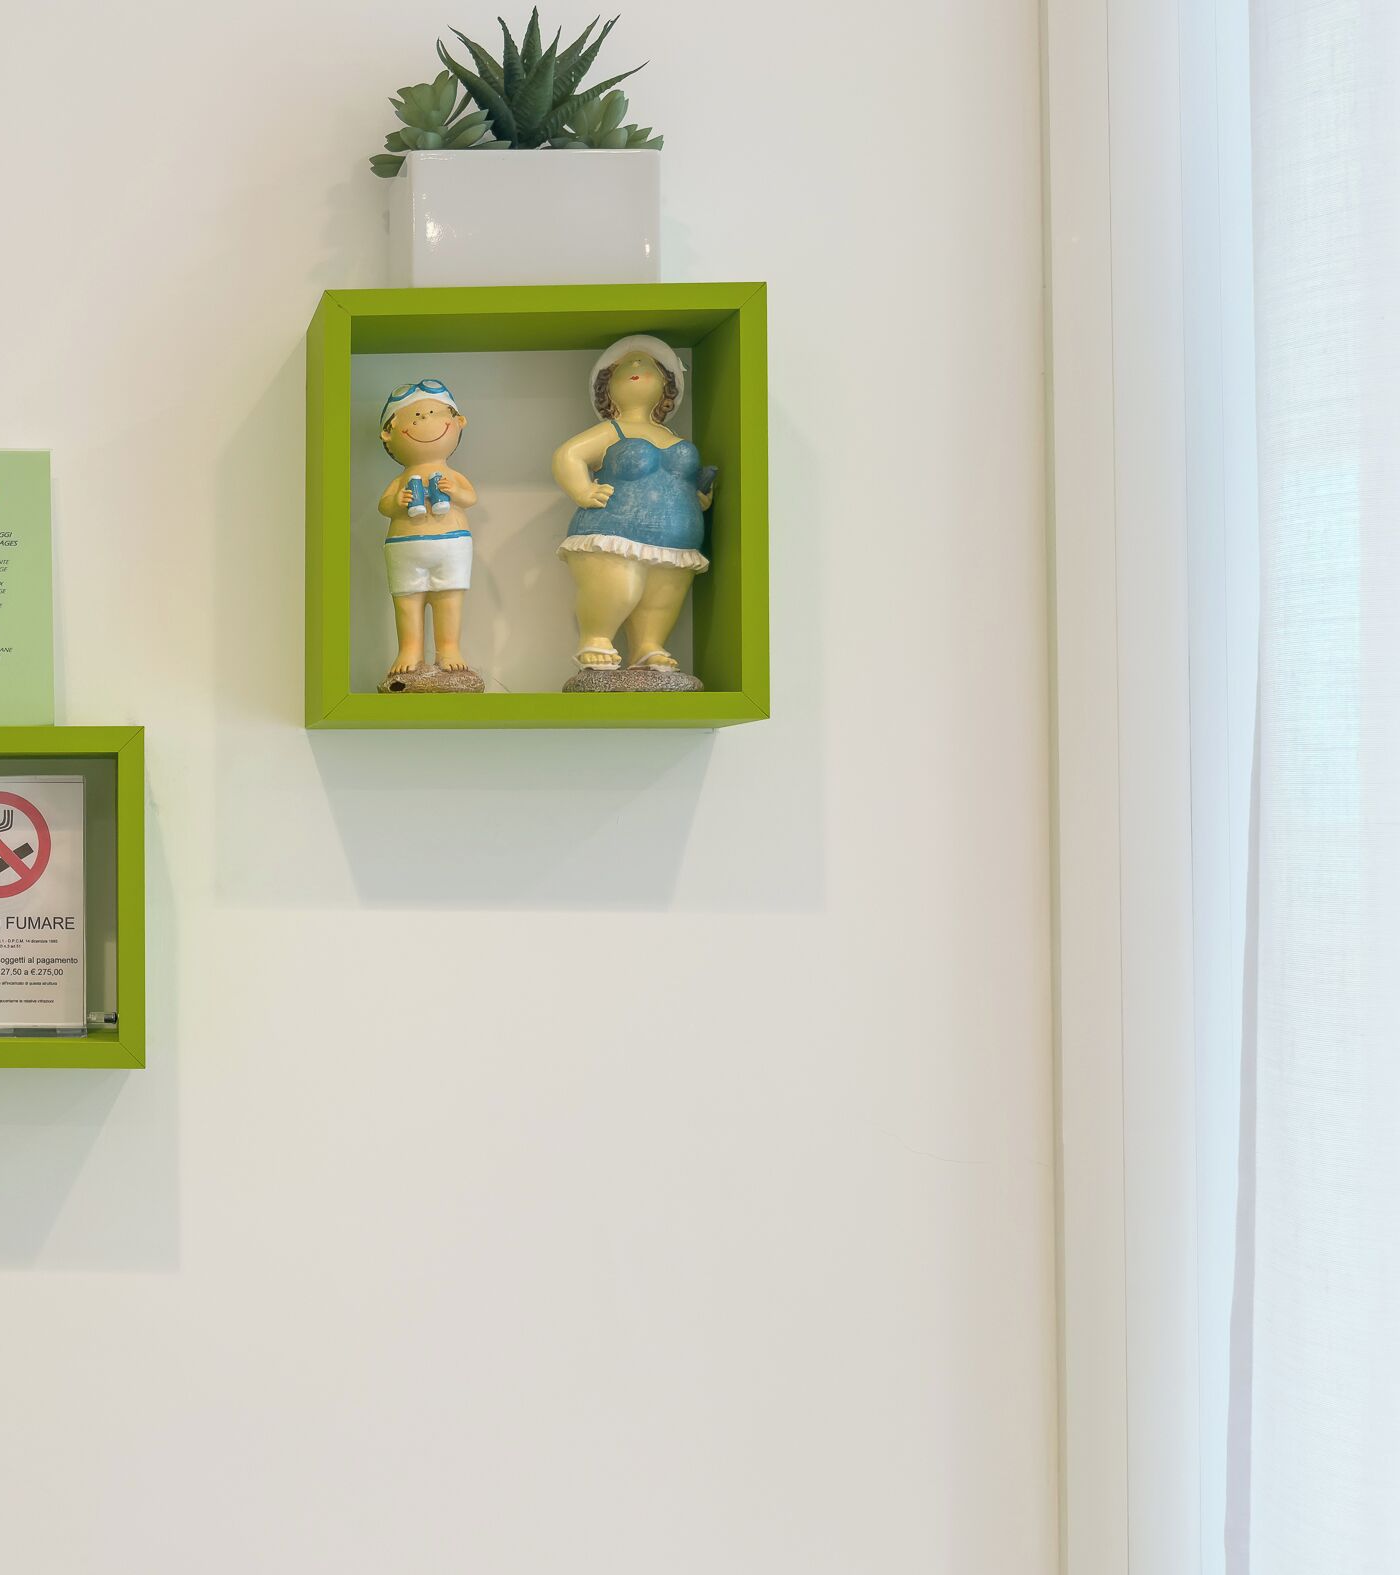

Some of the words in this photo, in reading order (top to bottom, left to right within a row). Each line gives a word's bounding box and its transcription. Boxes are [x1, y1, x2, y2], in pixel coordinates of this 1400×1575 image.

[5, 916, 75, 930] FUMARE
[36, 957, 79, 965] pagamento
[30, 969, 64, 977] €.275,00
